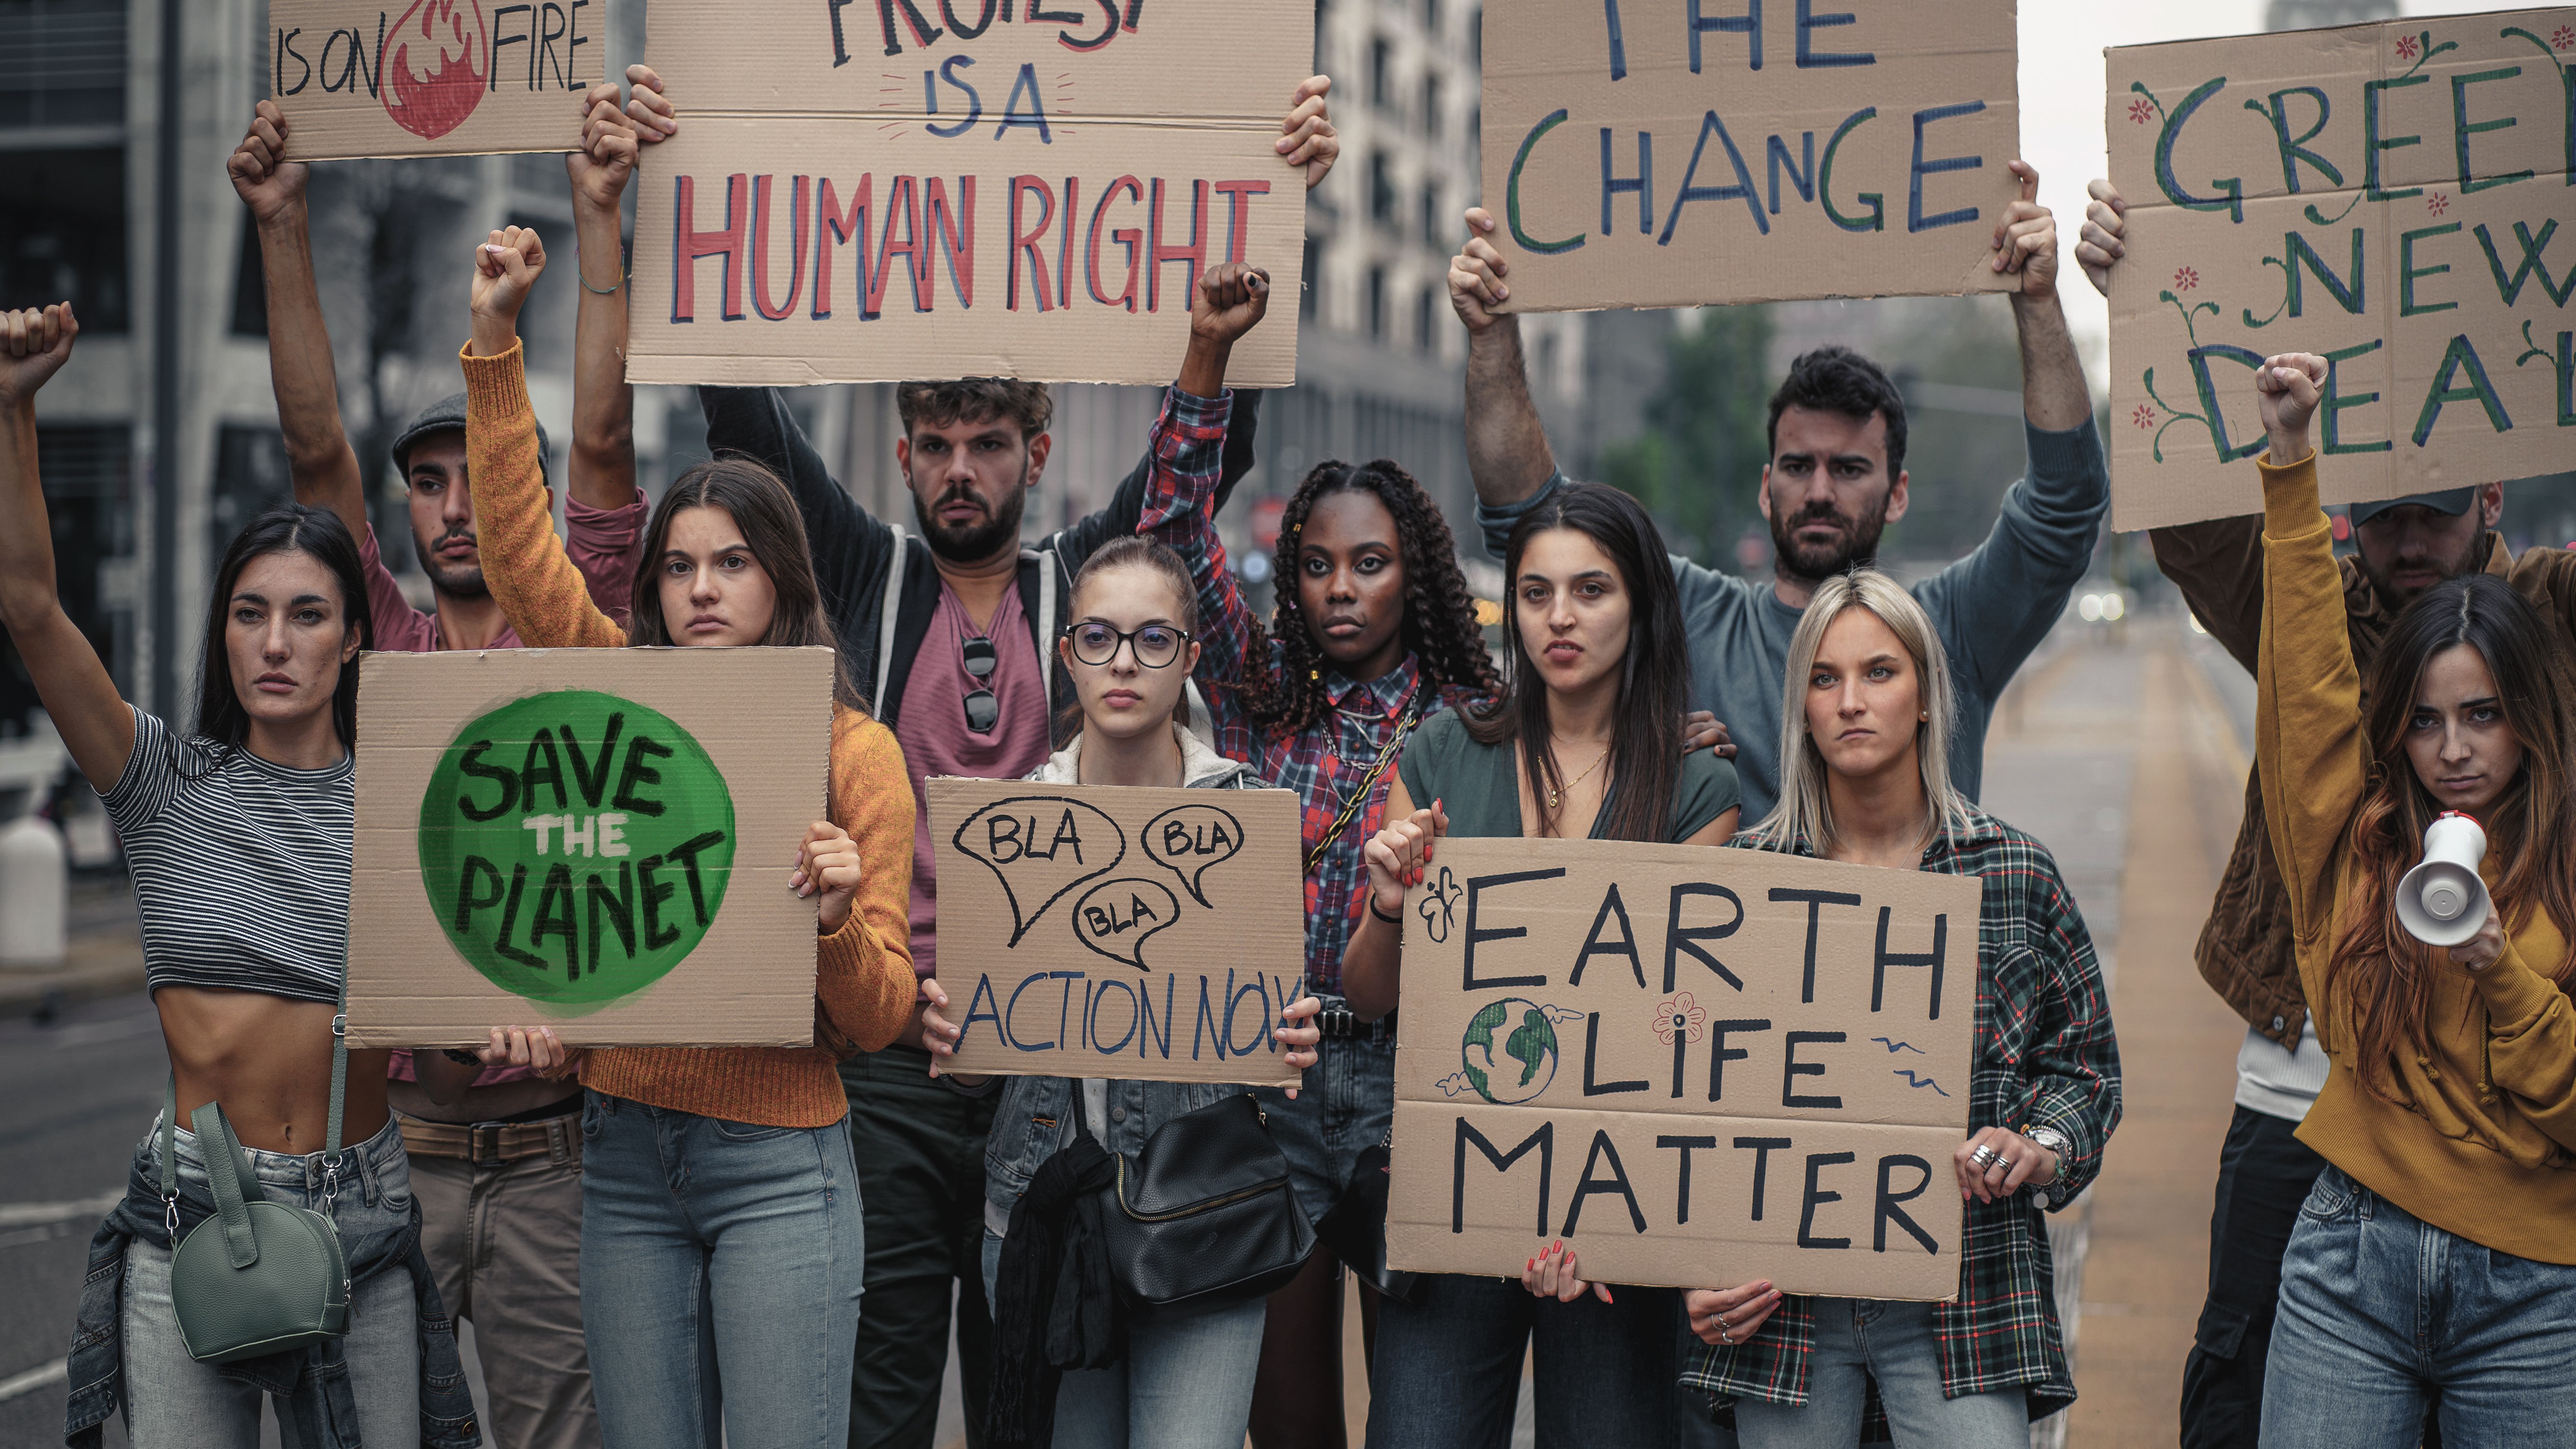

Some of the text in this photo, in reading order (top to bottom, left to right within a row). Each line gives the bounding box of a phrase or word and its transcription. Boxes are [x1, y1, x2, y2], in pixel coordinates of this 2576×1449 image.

[276, 0, 589, 100] IS ON FIRE
[923, 54, 1053, 145] IS A
[1506, 99, 1987, 255] CHANGE
[2154, 64, 2576, 224] GREE
[670, 172, 1271, 325] HUMAN RIGHT
[2285, 218, 2576, 318] NEW
[2187, 330, 2576, 464] DEAL
[457, 712, 674, 823] SAVE
[521, 812, 631, 858] THE
[987, 807, 1084, 865] BLA
[1163, 820, 1233, 856] BLA
[454, 829, 726, 983] PLANET
[1083, 892, 1157, 938] BLA
[1462, 867, 1948, 1021] EARTH
[952, 971, 1175, 1060] ACTION
[1452, 1116, 1939, 1256] MATTER
